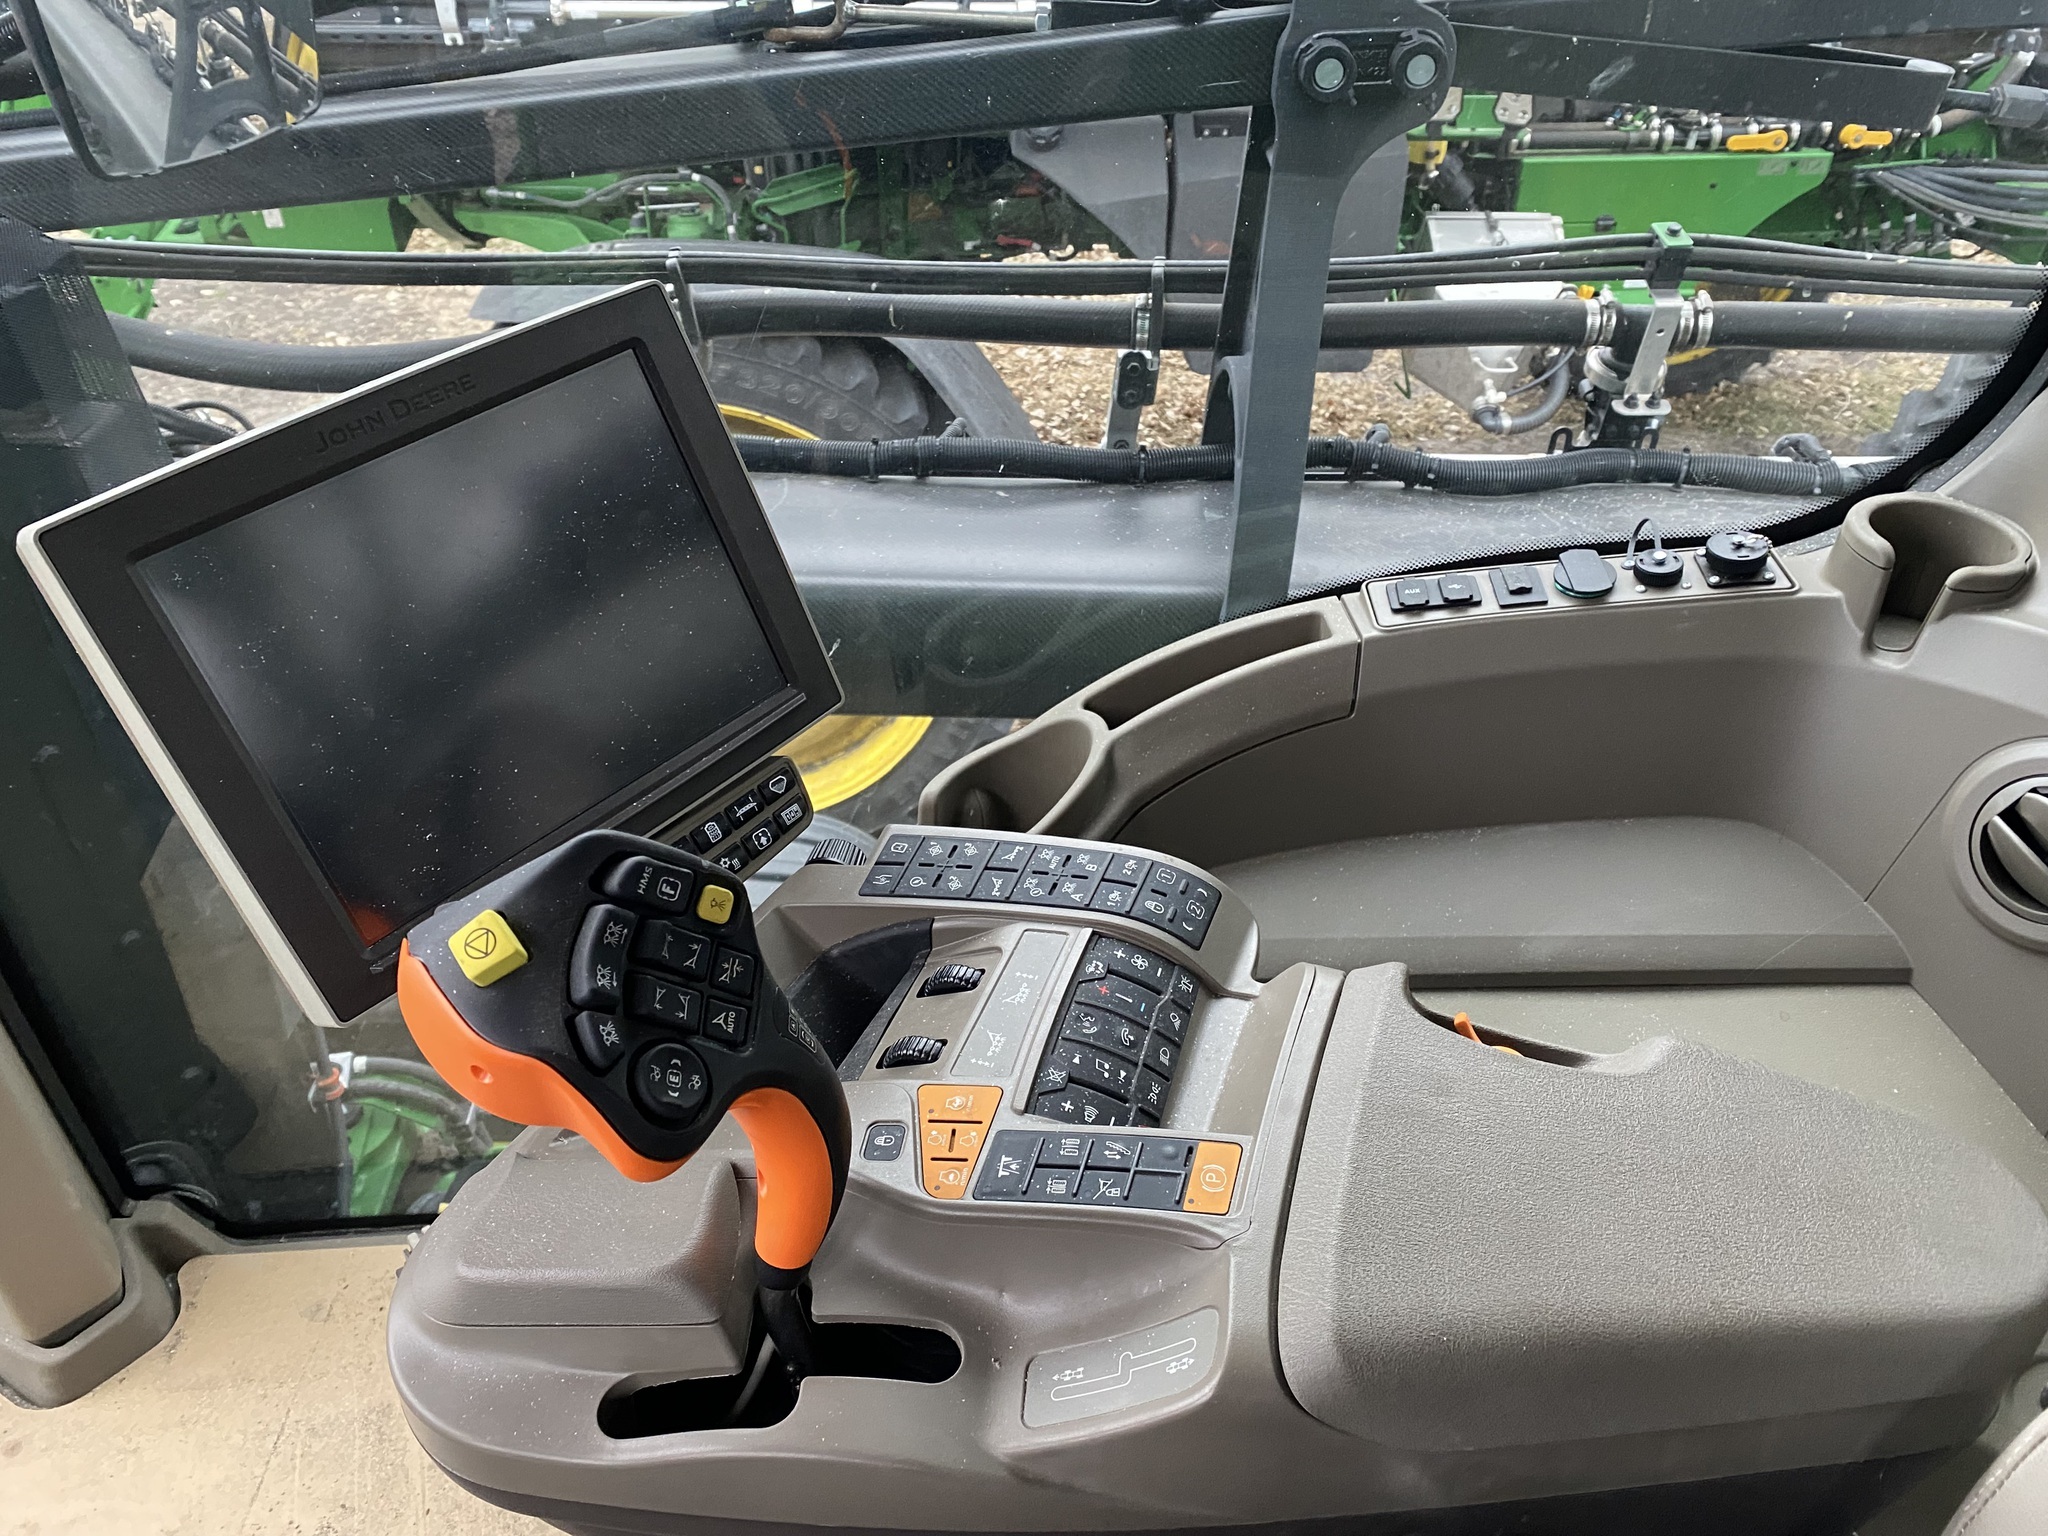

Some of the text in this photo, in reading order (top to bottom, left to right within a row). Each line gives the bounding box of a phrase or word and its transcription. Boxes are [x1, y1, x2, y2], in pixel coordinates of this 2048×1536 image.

[315, 374, 476, 454] JOHN DEERE
[1048, 855, 1061, 870] AUTO
[1084, 864, 1098, 872] B
[1123, 867, 1132, 876] 2
[637, 866, 653, 895] HMS
[1070, 893, 1084, 903] A
[726, 1011, 736, 1034] AUTO
